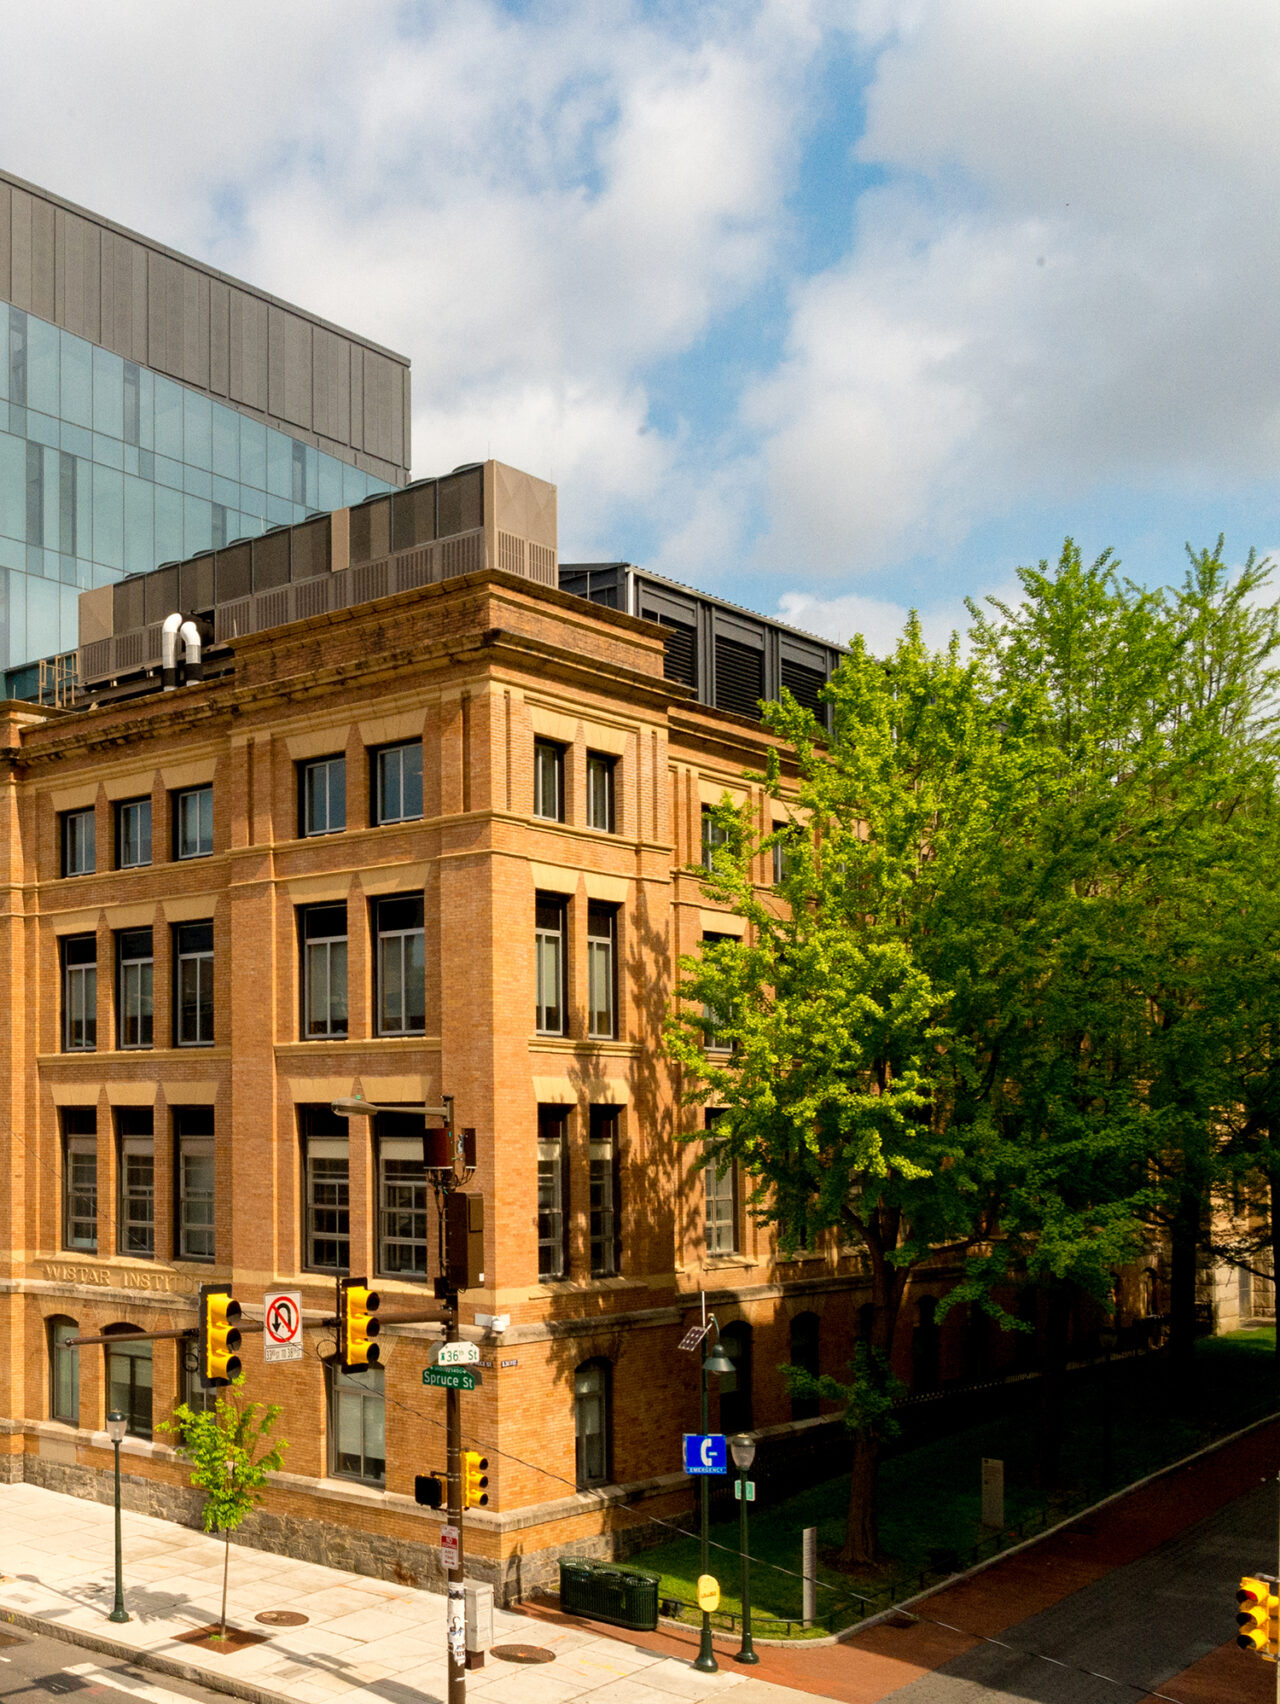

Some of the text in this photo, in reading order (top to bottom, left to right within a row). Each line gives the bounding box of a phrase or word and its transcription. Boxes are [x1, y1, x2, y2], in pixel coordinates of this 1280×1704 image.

[45, 1264, 208, 1294] WISTAR INSTITU
[446, 1349, 478, 1362] 36th St
[424, 1371, 473, 1389] Spruce St
